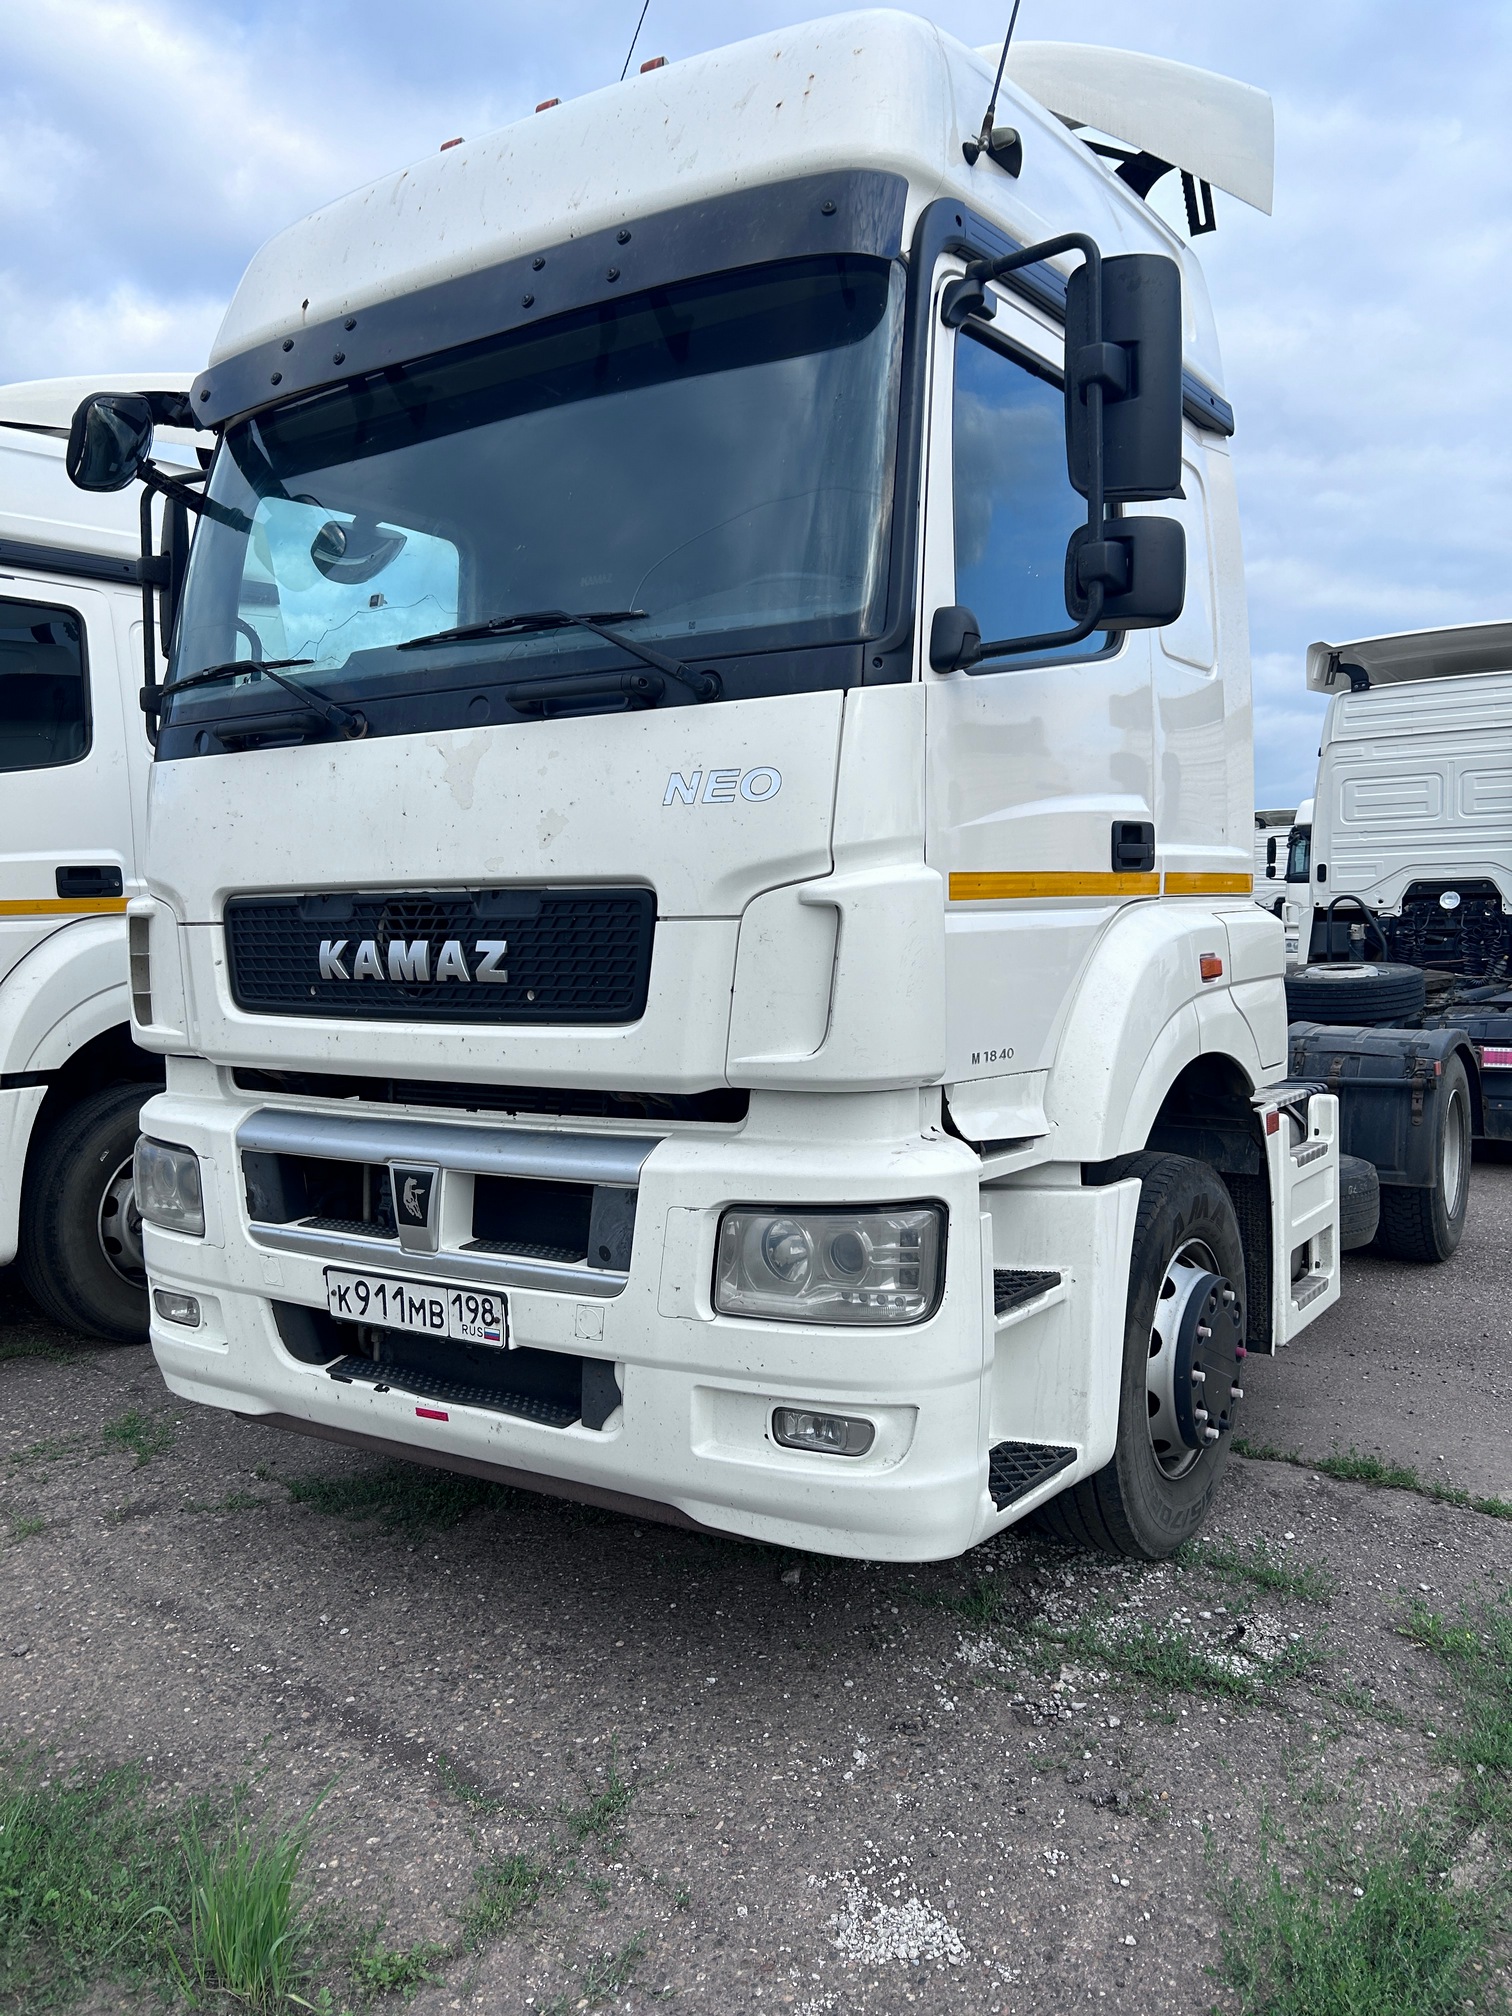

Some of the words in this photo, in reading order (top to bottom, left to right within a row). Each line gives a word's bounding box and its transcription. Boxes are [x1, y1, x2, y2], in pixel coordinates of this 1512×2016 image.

[662, 766, 782, 806] NEO
[319, 940, 508, 983] KAMAZ
[451, 1293, 495, 1327] 198
[461, 1324, 484, 1339] RUS
